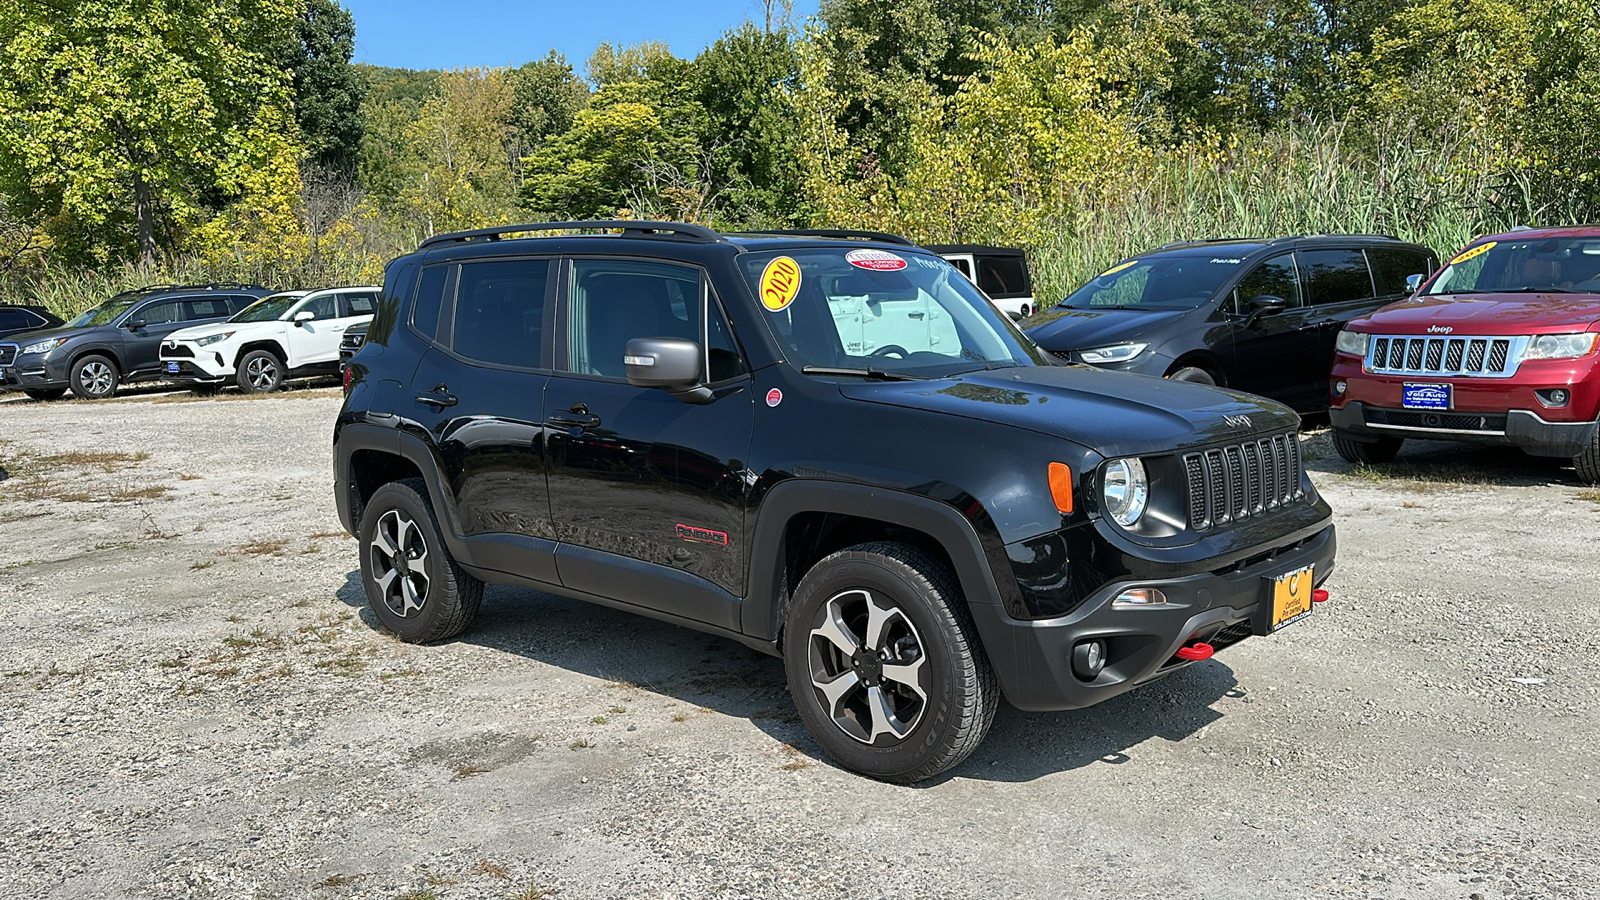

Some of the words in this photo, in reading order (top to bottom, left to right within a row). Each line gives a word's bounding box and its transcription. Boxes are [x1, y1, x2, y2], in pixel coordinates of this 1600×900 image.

[765, 261, 795, 305] 2020
[1427, 324, 1453, 334] Jeep
[1222, 414, 1252, 428] Jeep
[676, 524, 727, 545] RENEGADE
[1285, 598, 1301, 609] Certified
